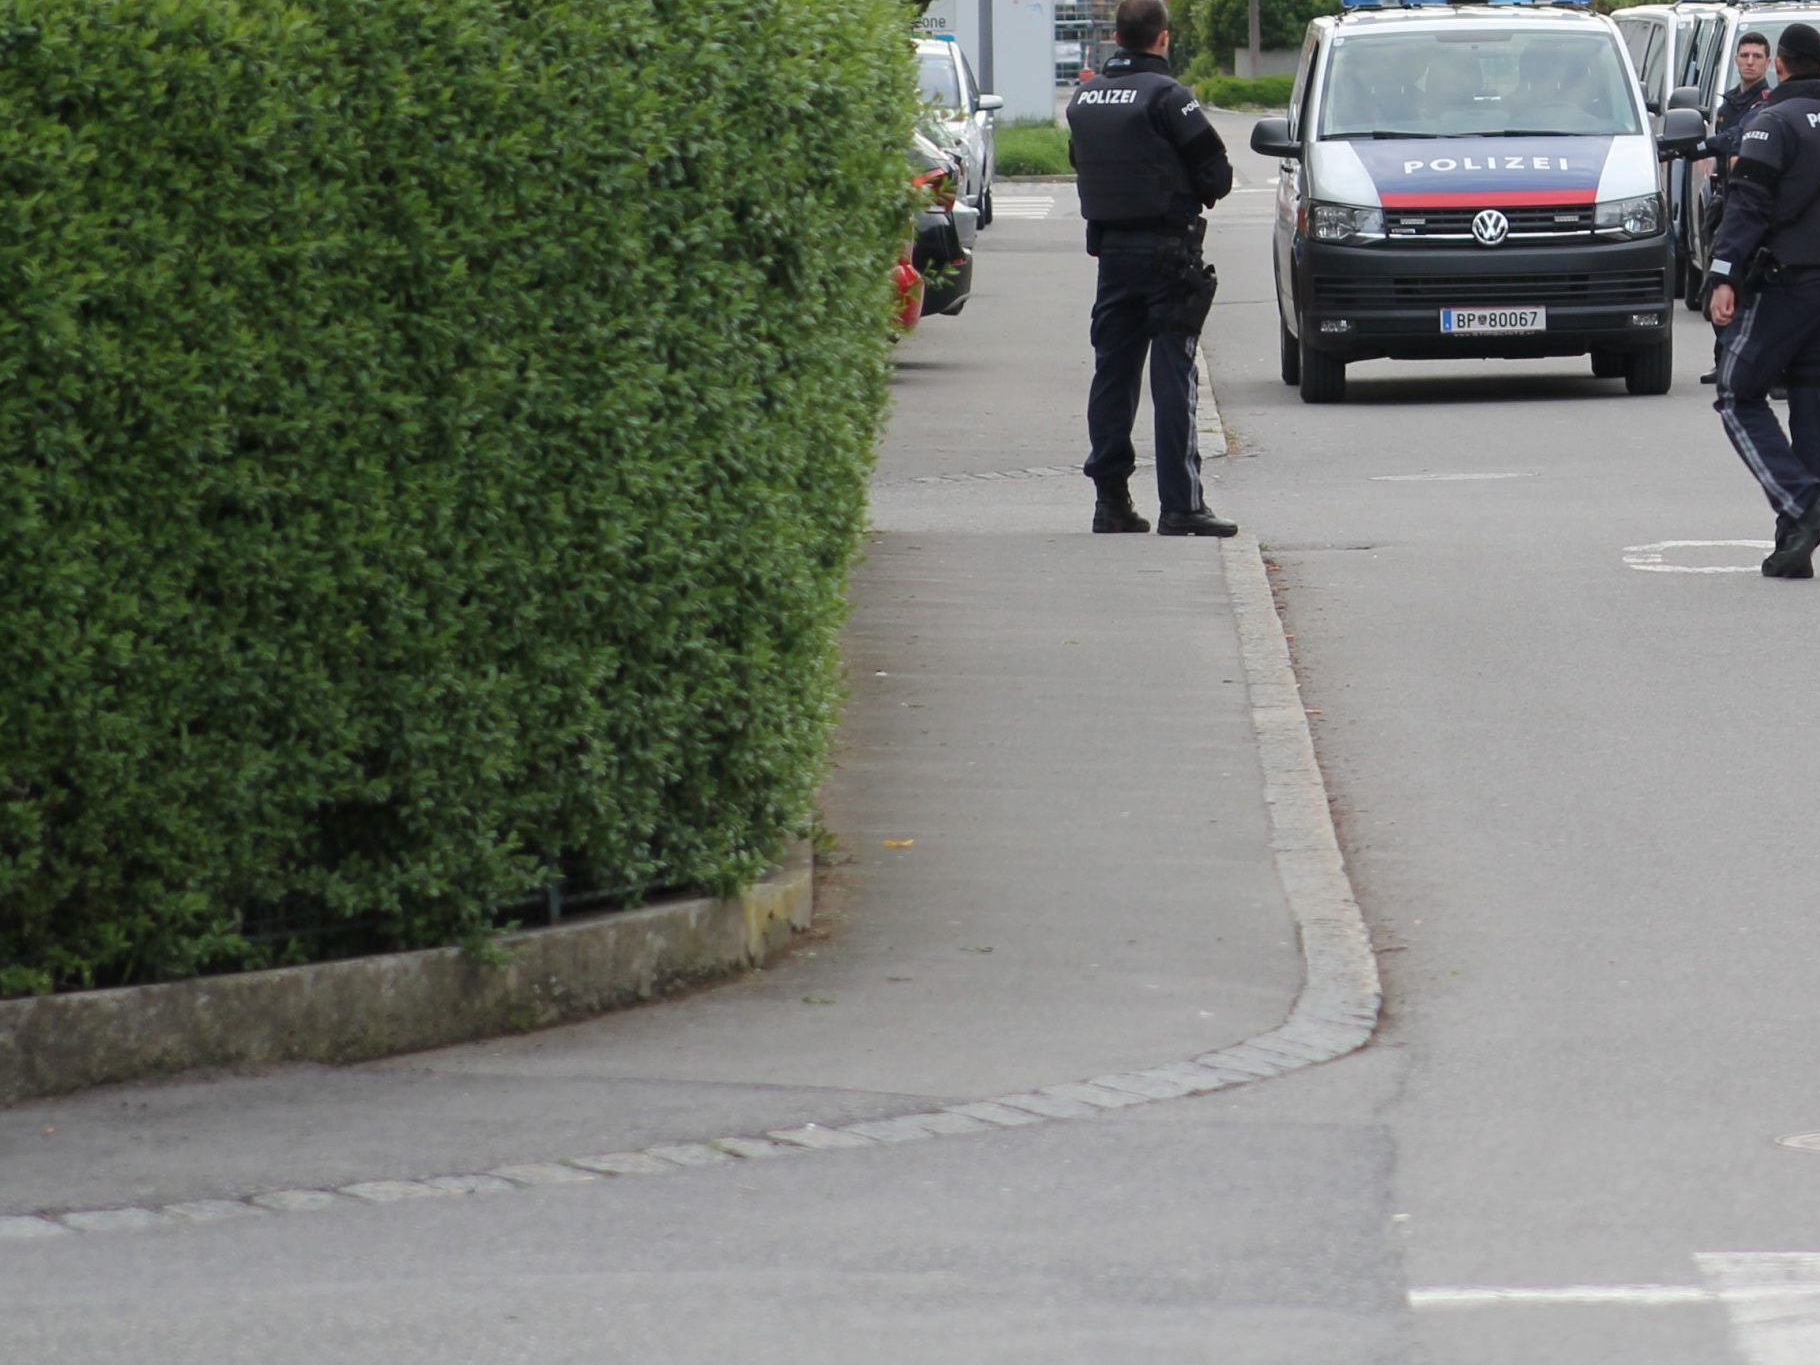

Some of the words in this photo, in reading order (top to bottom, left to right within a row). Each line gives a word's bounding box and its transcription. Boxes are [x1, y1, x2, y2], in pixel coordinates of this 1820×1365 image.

[1077, 89, 1137, 105] POLIZEI
[1403, 157, 1568, 174] POLIZEI
[1472, 209, 1508, 245] VW
[1457, 313, 1476, 329] BP
[1488, 312, 1538, 328] 80067
